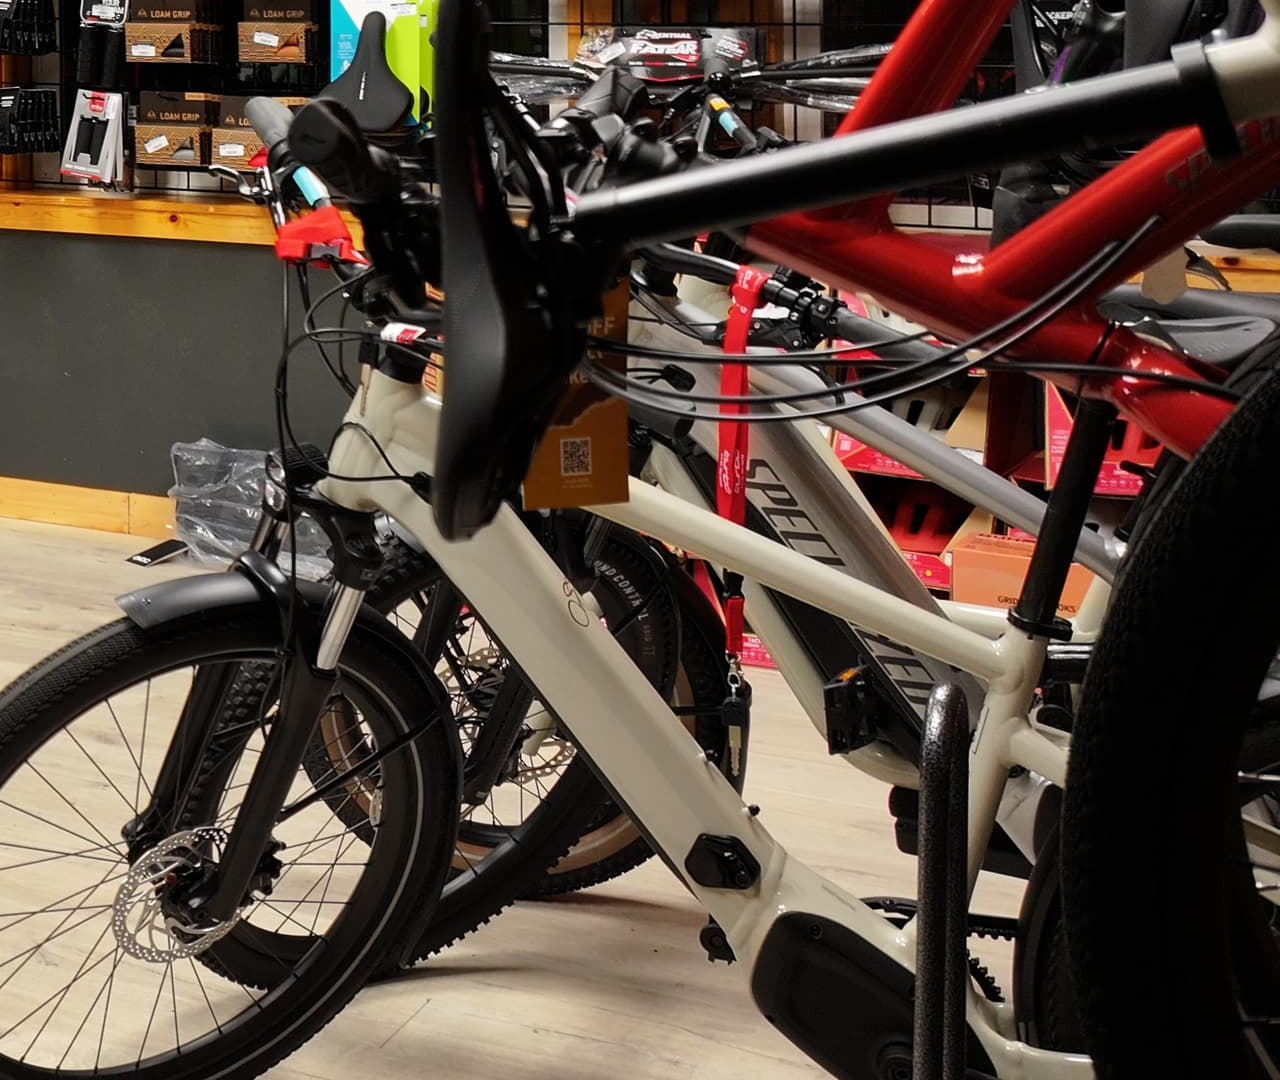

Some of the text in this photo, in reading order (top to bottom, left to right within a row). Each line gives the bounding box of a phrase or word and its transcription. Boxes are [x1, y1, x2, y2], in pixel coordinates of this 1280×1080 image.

[150, 9, 192, 19] LOAM GRIP
[262, 9, 305, 19] LOAM GRIP
[159, 111, 201, 122] LOAM GRIP
